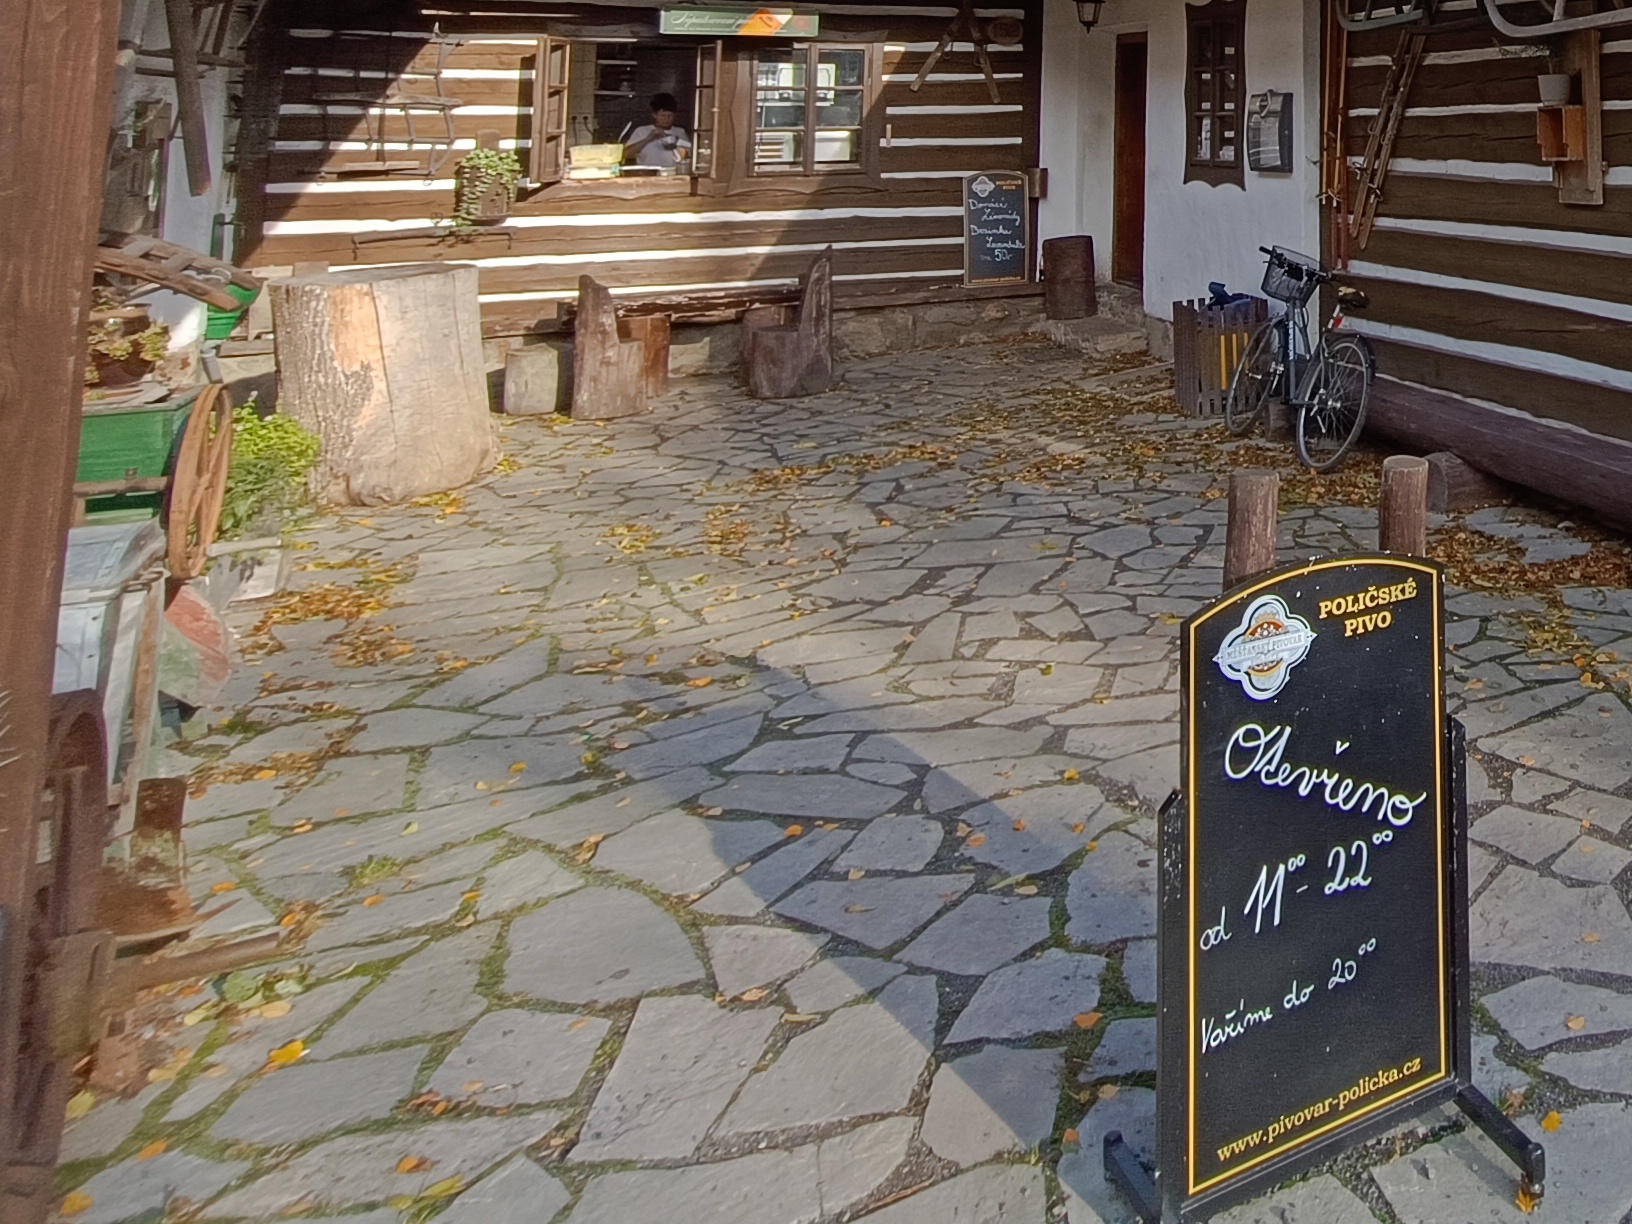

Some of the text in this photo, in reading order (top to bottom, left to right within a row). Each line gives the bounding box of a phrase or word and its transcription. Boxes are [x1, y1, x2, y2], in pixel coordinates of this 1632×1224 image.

[1319, 577, 1417, 618] POLIČSKÉ
[1345, 611, 1392, 637] PIVO
[1225, 723, 1427, 826] Otevřeno
[1200, 906, 1232, 950] od
[1283, 980, 1314, 1009] do
[1216, 1057, 1421, 1162] www.pivovar-policka.cz
